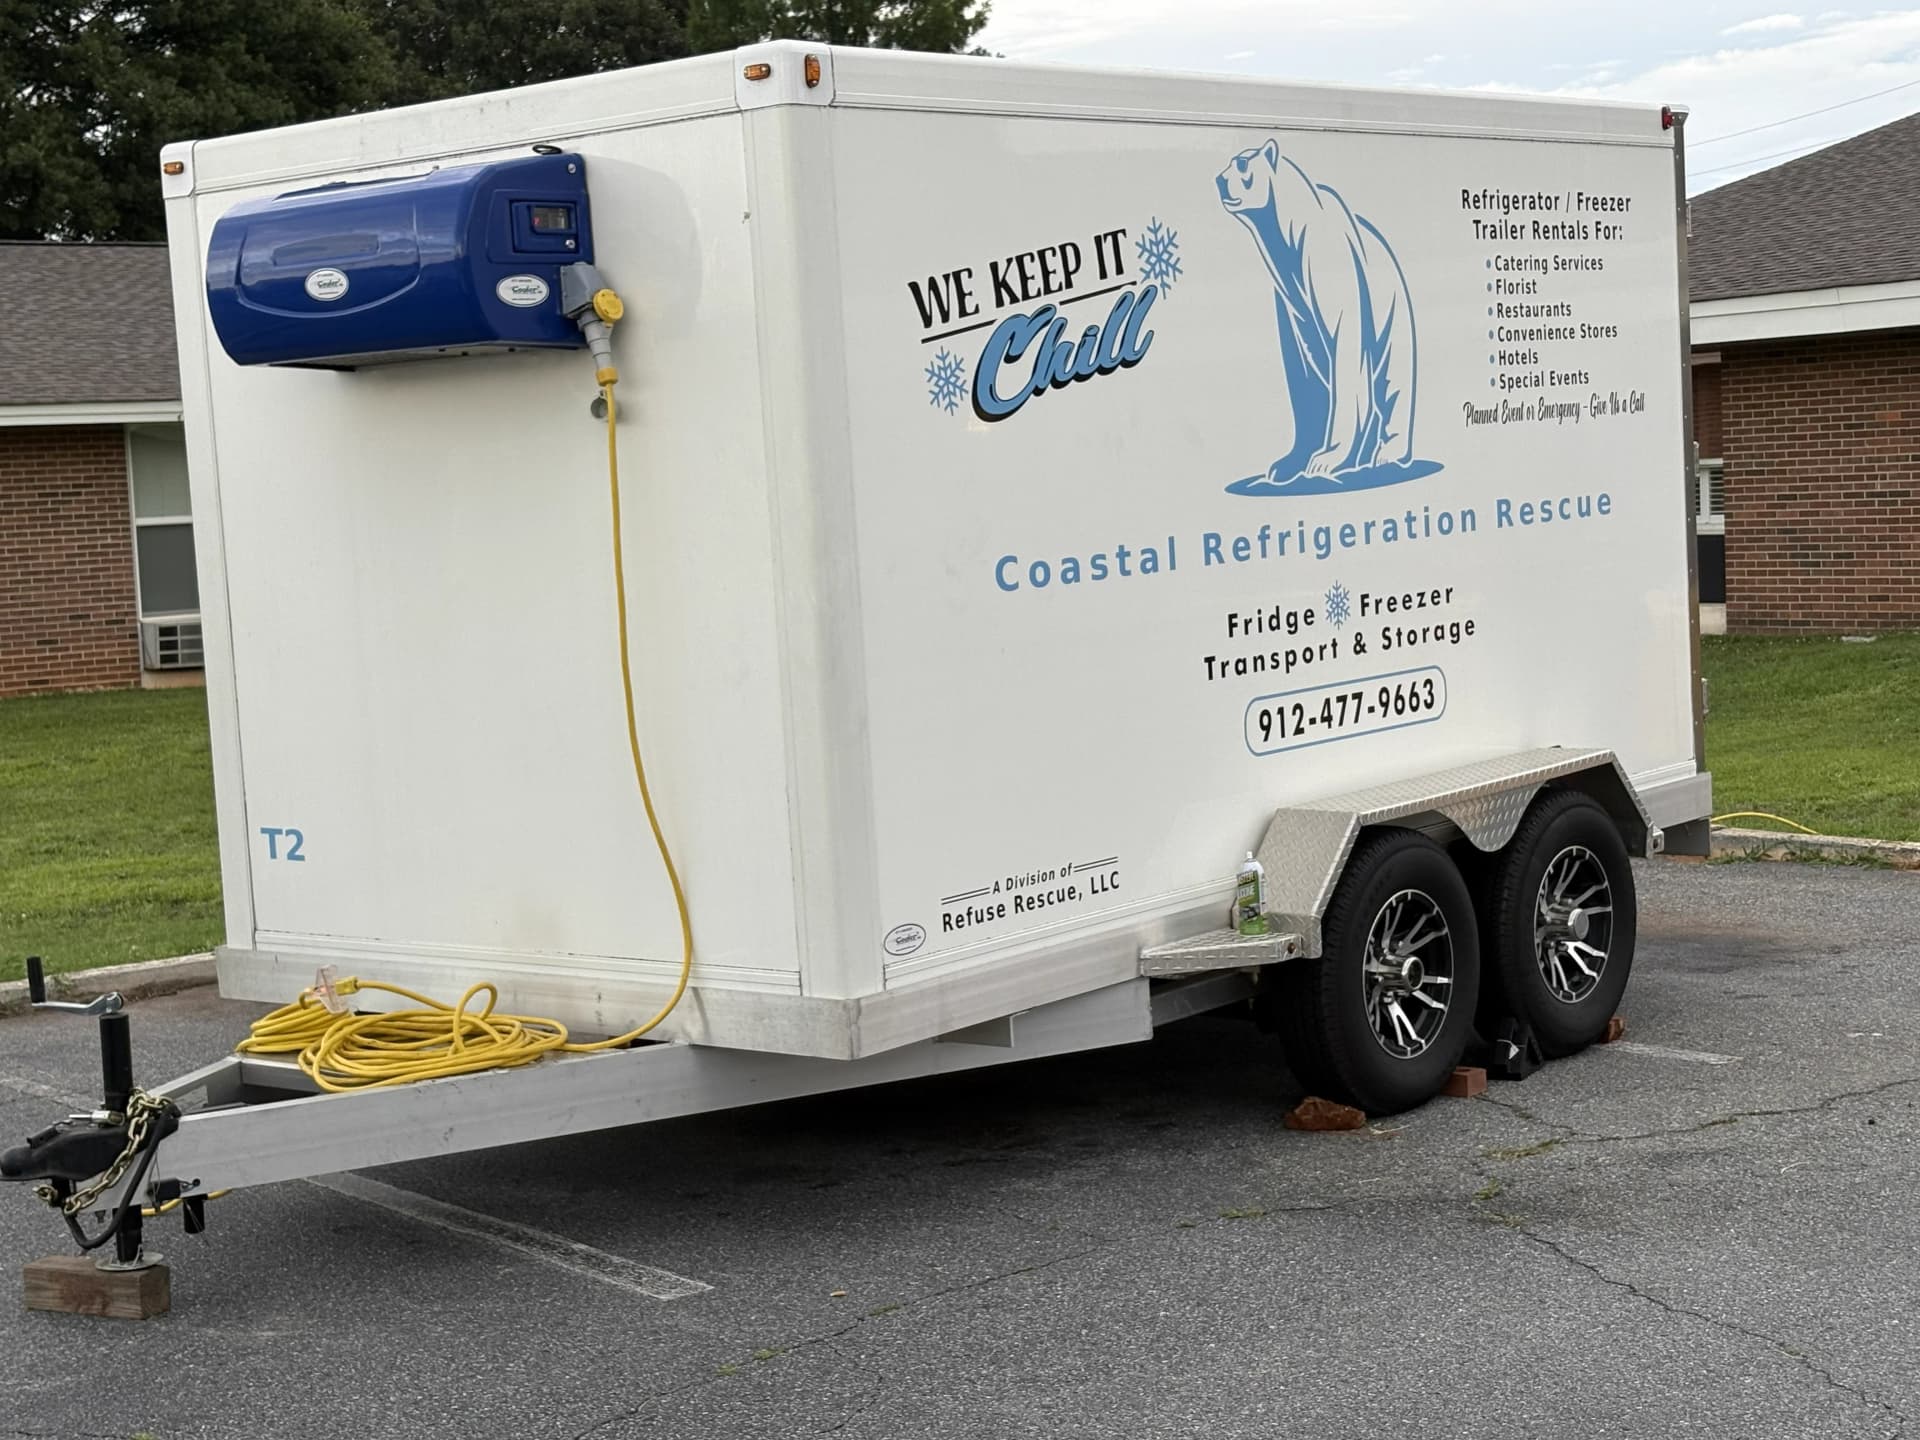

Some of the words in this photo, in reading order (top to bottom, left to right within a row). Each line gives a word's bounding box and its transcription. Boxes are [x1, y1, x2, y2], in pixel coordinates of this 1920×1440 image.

[1462, 189, 1560, 215] Refrigerator
[1566, 192, 1570, 213] /
[1577, 192, 1631, 212] Freezer
[1473, 220, 1525, 240] Trailer
[1533, 220, 1588, 240] Rentals
[1595, 221, 1623, 240] For:
[907, 268, 980, 329] WE
[989, 242, 1081, 308] KEEP
[1094, 229, 1127, 280] IT
[1495, 255, 1548, 275] Catering
[1553, 255, 1603, 270] Services
[1496, 278, 1537, 294] Florist
[1497, 302, 1572, 318] Restaurants
[1497, 324, 1575, 342] Convenience
[1580, 324, 1617, 338] Stores
[972, 285, 1158, 423] Chill
[1499, 349, 1538, 366] Hotels
[1499, 371, 1544, 393] Special
[1550, 369, 1589, 386] Events
[1463, 402, 1498, 427] Planned
[1502, 399, 1524, 424] Event
[1526, 407, 1535, 420] or
[1538, 397, 1580, 424] Emergency
[1590, 393, 1607, 418] Give
[1610, 392, 1620, 415] Us
[1622, 399, 1628, 413] a
[1630, 390, 1644, 414] Call
[994, 535, 1176, 592] Coastal
[1203, 505, 1476, 566] Refrigeration
[1496, 493, 1611, 529] Rescue
[1227, 602, 1315, 639] Fridge
[1359, 584, 1455, 617] Freezer
[1204, 637, 1339, 681] Transport
[1353, 633, 1367, 656] &
[1381, 617, 1476, 651] Storage
[1259, 678, 1435, 742] 912-477-9663
[260, 828, 305, 861] T2
[992, 881, 1000, 894] A
[1005, 868, 1055, 892] Division
[1060, 863, 1073, 877] of
[943, 901, 1006, 932] Refuse
[1014, 885, 1083, 915] Rescue,
[1090, 871, 1120, 895] LLC
